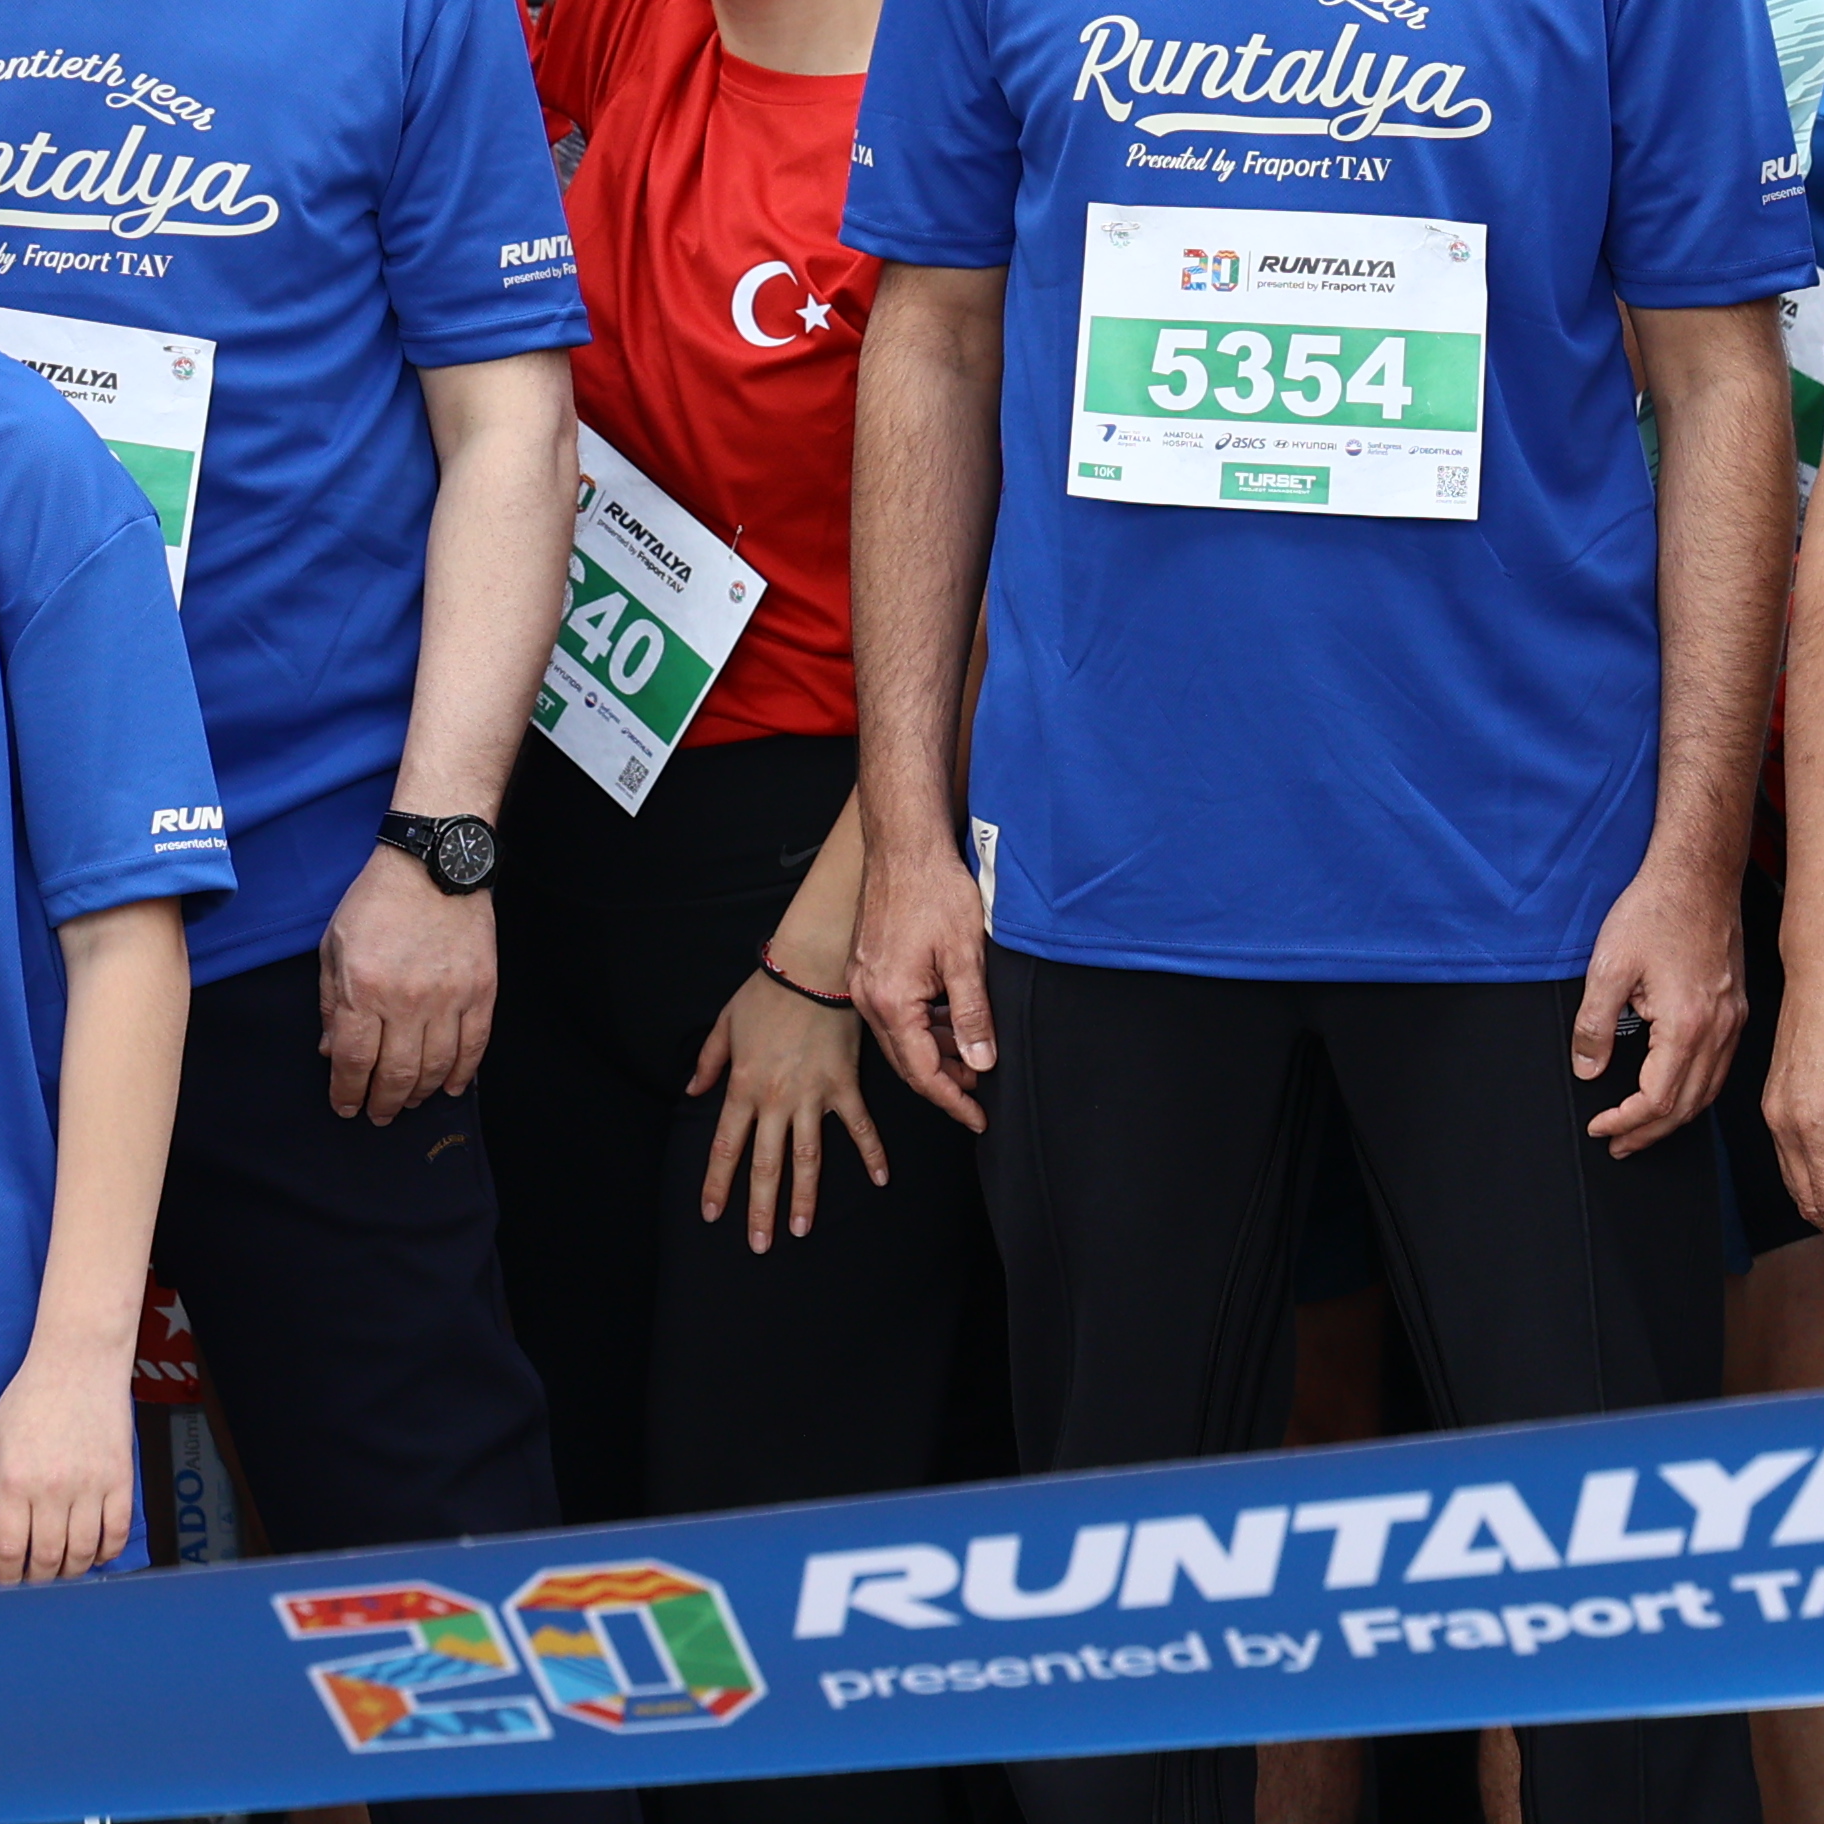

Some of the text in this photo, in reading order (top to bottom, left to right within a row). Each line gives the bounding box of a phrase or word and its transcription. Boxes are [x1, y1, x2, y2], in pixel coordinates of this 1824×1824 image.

[1073, 14, 1492, 142] Runtalya
[105, 71, 216, 132] year
[1127, 143, 1392, 182] Presented by Fraport TAV
[23, 244, 111, 274] Fraport
[116, 251, 174, 278] TAV
[1181, 248, 1397, 292] 20 RUNTALYA
[503, 267, 551, 288] presented
[1257, 279, 1396, 294] presented Fraport TAV
[1147, 328, 1412, 420] 5354
[91, 392, 116, 404] TAV
[1162, 439, 1203, 449] HOSPITAL
[1163, 431, 1204, 440] ANATOLIA
[1292, 441, 1338, 451] HYUNDAI
[1093, 466, 1115, 478] 10K
[1234, 471, 1316, 490] TURSET
[603, 501, 693, 584] RUNTALYA
[637, 551, 685, 594] Fraport TAV
[151, 806, 223, 834] RUN
[155, 837, 212, 853] presented
[272, 1559, 764, 1753] 20
[818, 1629, 1226, 1711] presented
[1236, 1618, 1323, 1678] by
[1341, 1580, 1721, 1664] Fraport
